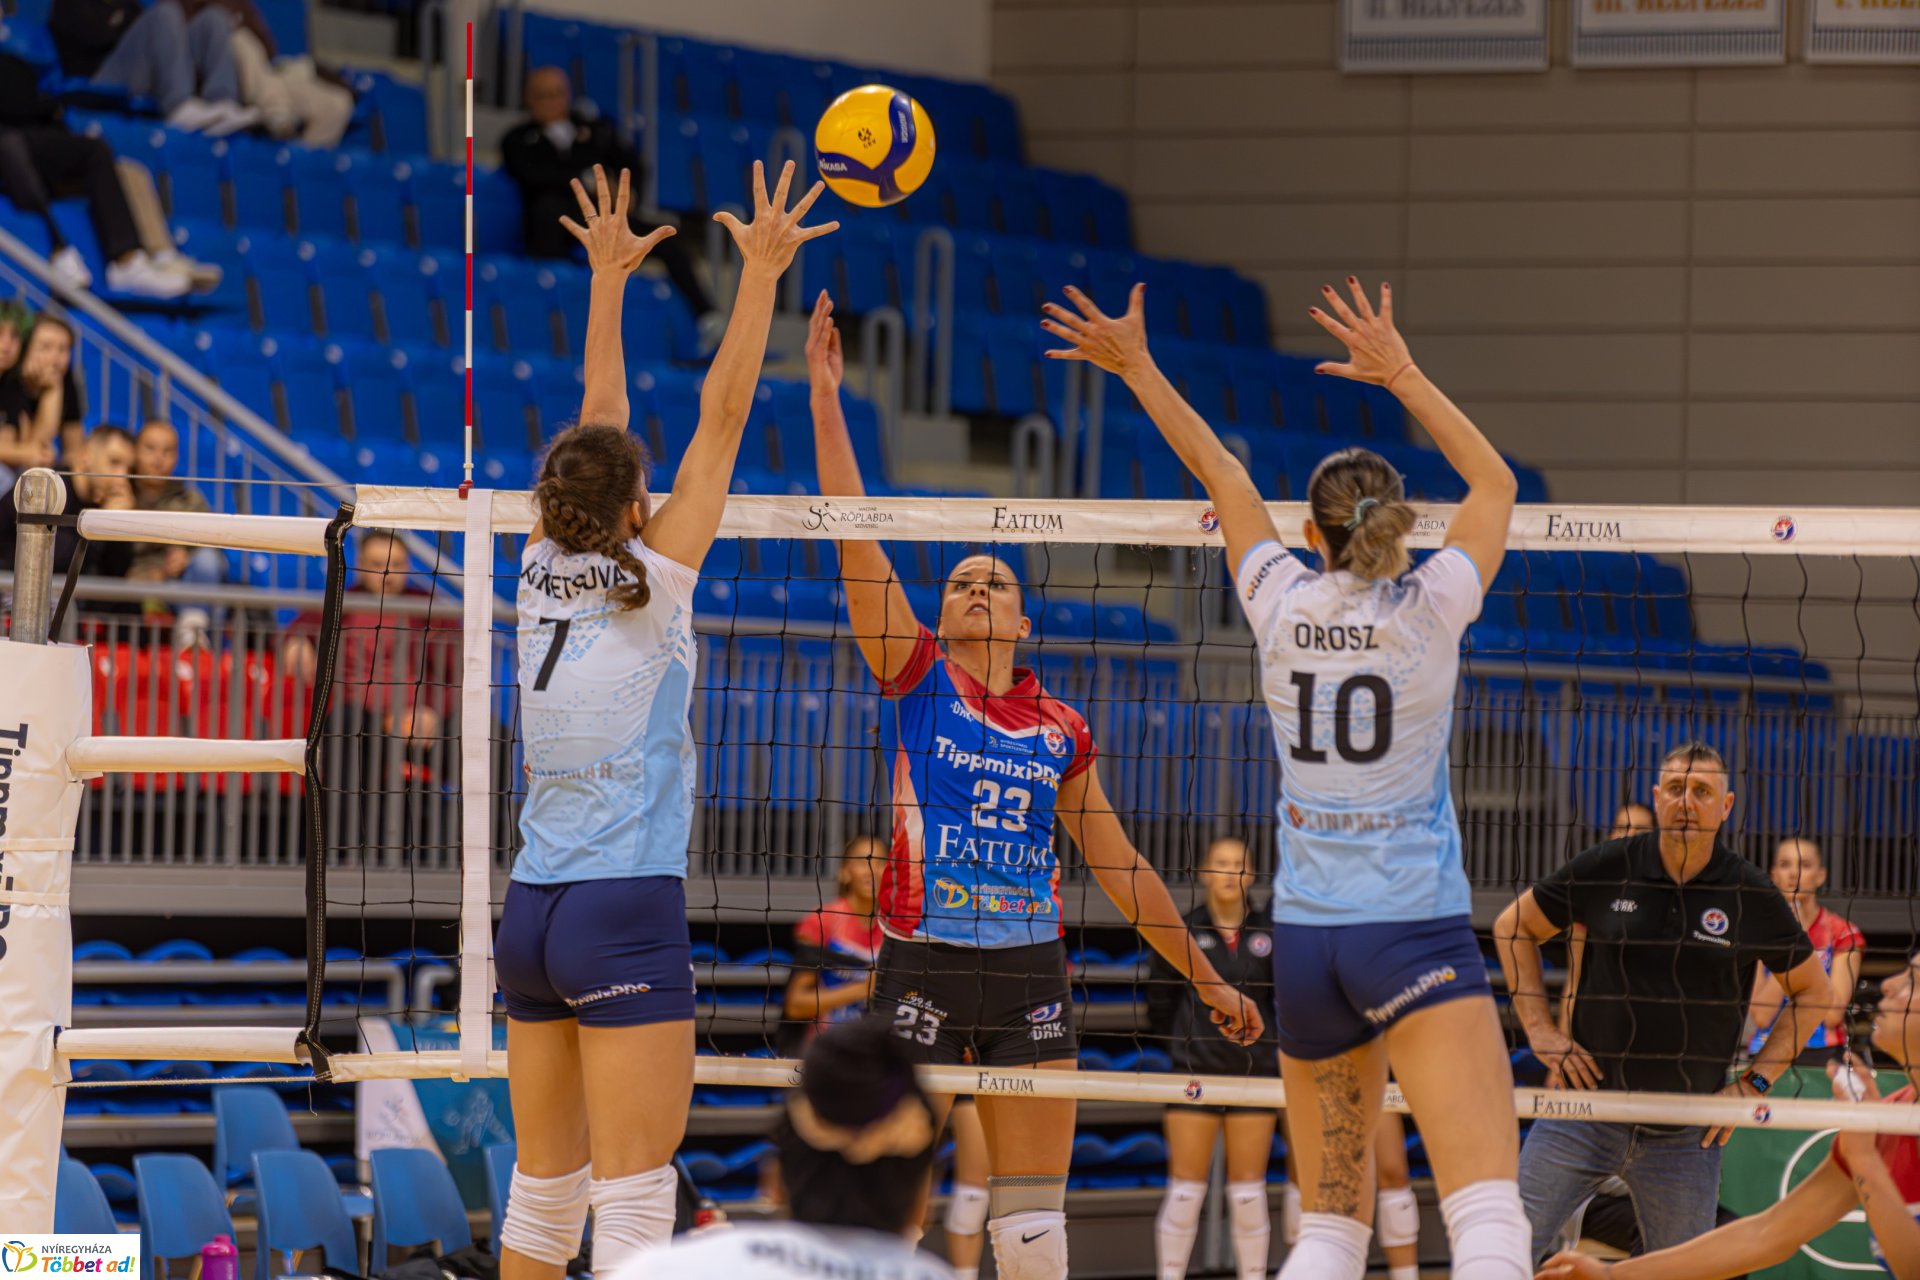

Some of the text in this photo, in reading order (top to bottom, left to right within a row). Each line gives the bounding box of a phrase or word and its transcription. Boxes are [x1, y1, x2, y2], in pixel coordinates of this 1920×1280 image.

[840, 511, 894, 523] RÖPLABDA
[533, 616, 571, 692] 7
[1294, 623, 1379, 651] OROSZ
[1289, 669, 1394, 766] 10
[970, 778, 1032, 833] 23
[893, 1003, 941, 1047] 23
